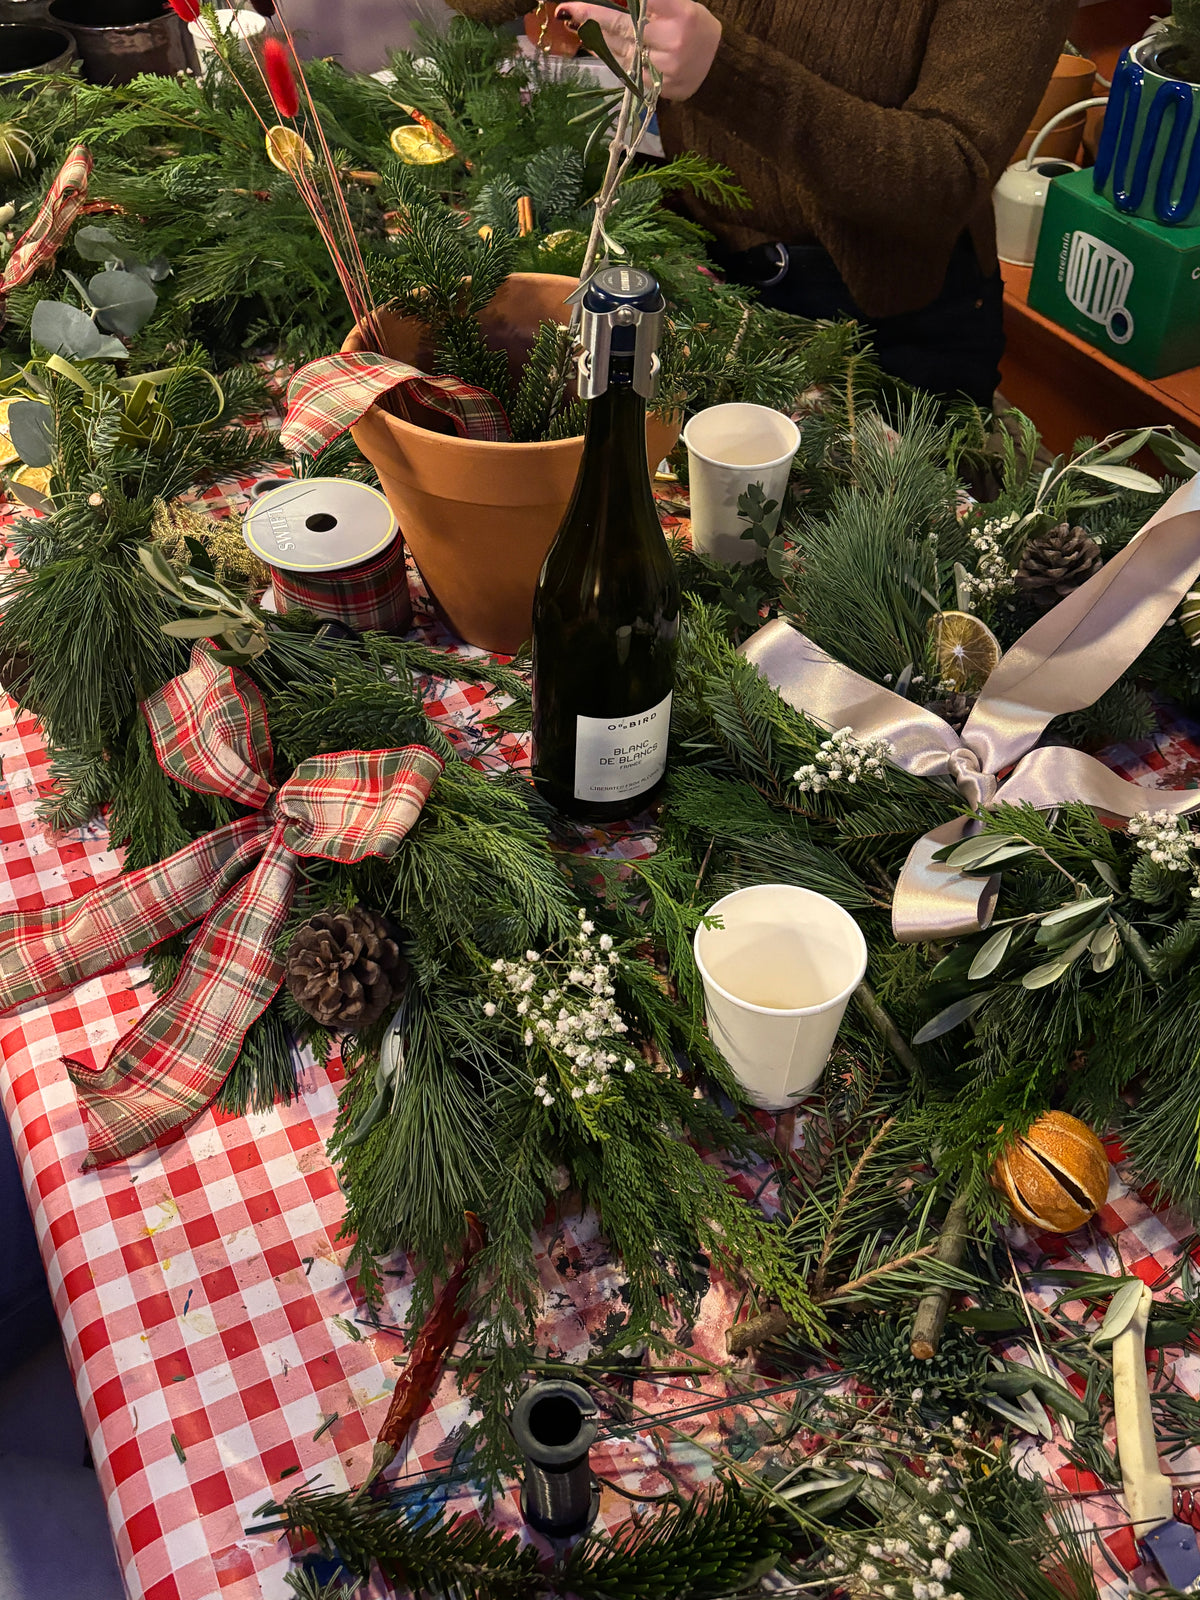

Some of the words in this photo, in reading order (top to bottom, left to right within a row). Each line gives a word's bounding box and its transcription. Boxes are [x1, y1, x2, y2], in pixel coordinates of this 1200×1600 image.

[267, 508, 295, 551] SWIFT
[599, 757, 615, 766] DE
[619, 742, 658, 764] BLANCS
[614, 739, 649, 756] BLANC
